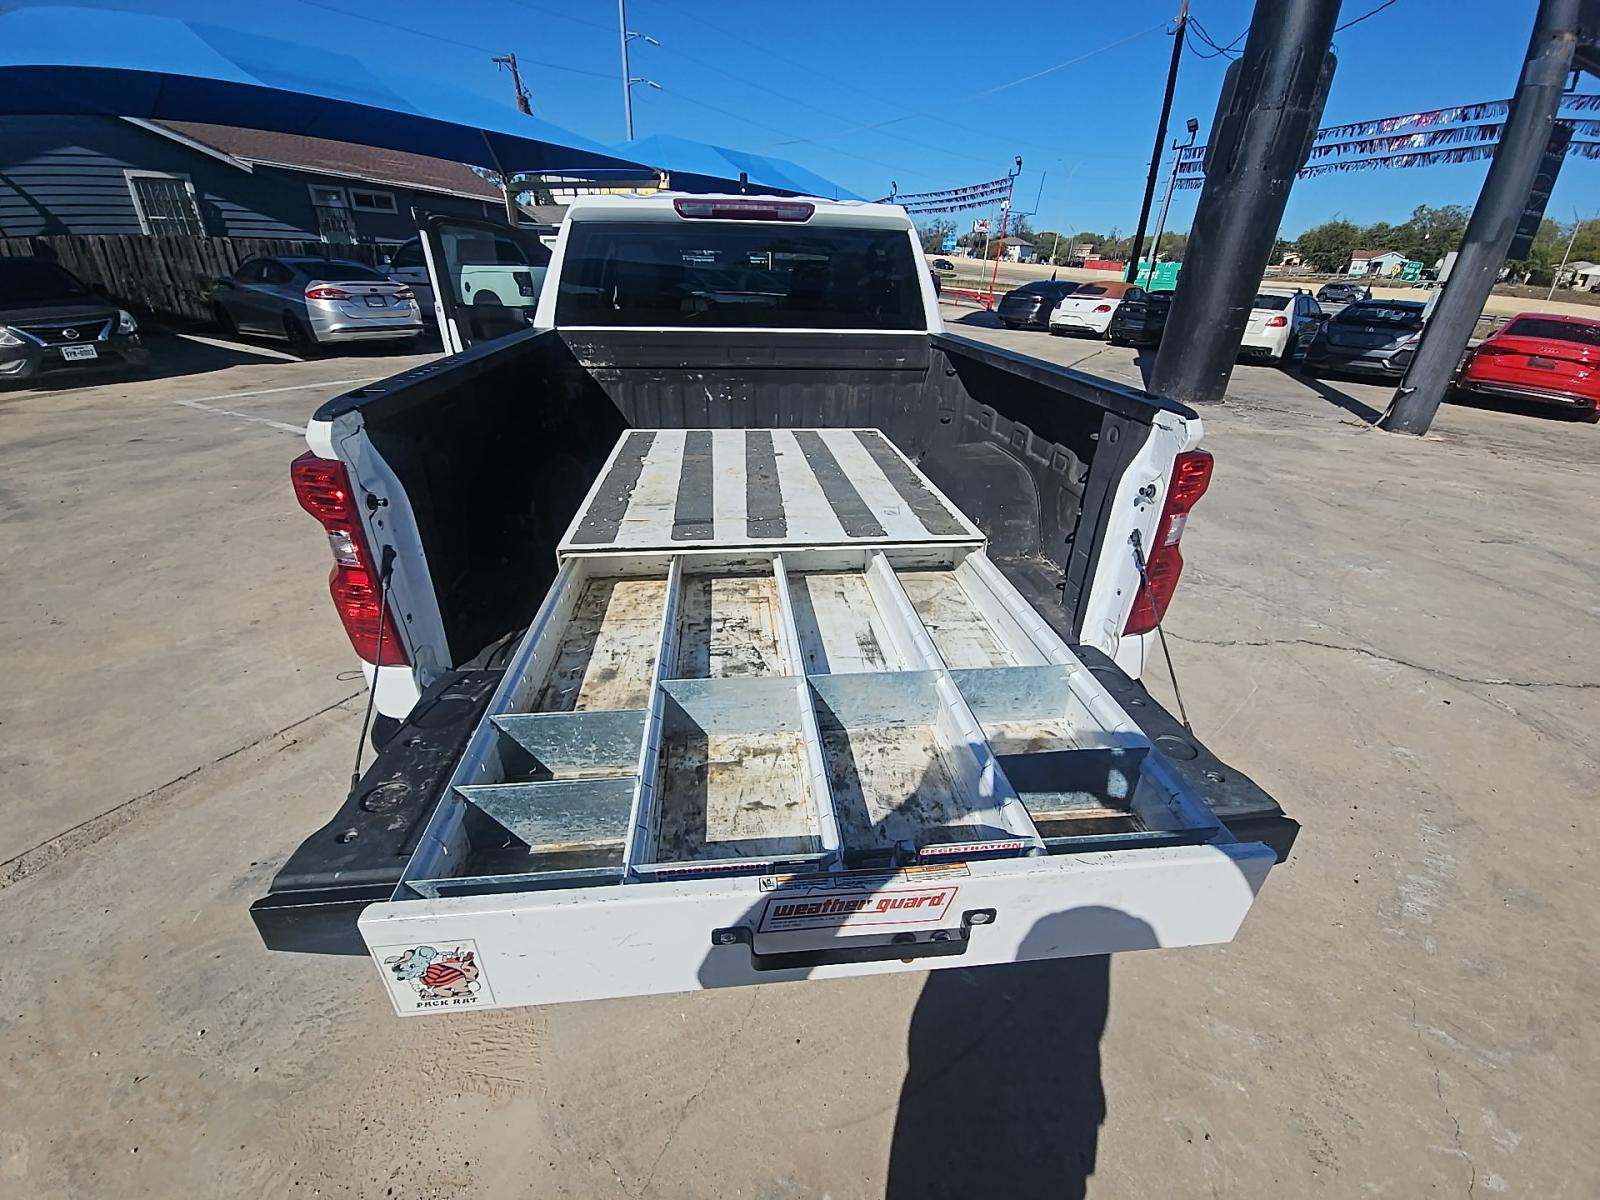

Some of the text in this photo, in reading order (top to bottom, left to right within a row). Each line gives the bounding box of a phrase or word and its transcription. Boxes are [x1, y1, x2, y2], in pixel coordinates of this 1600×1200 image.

[773, 892, 946, 917] weather guard
[416, 997, 478, 1008] PACK RAT
